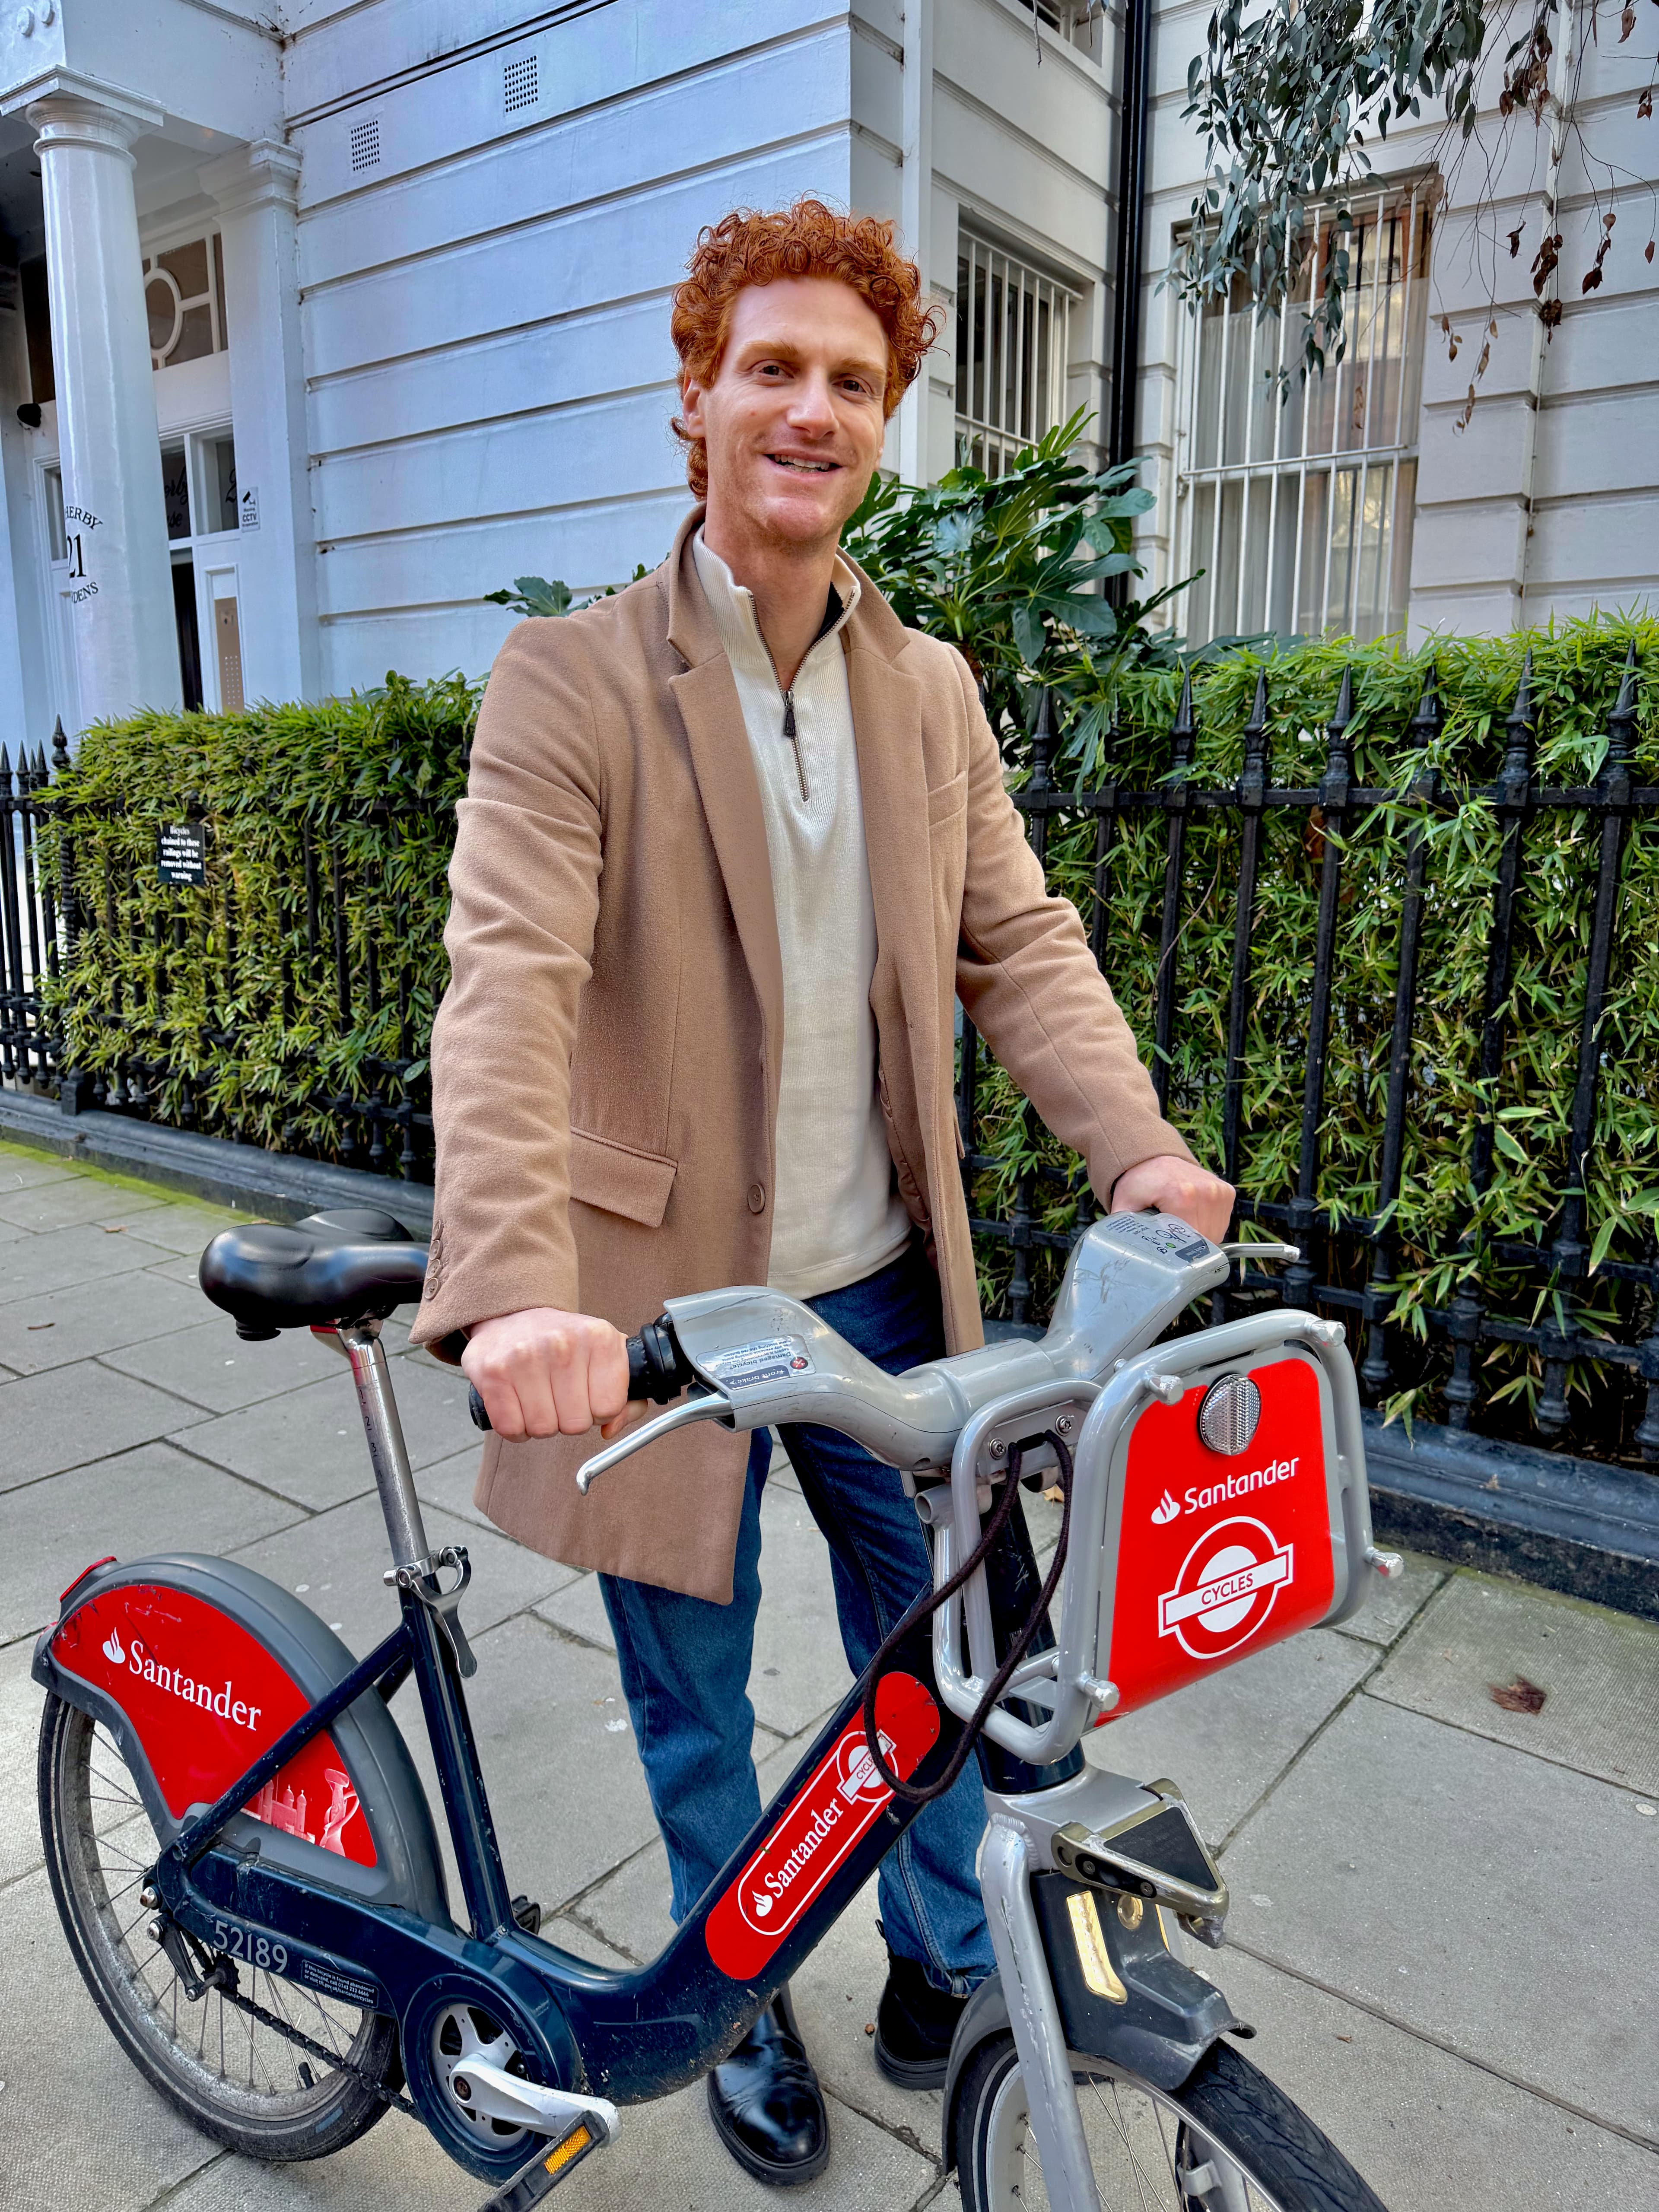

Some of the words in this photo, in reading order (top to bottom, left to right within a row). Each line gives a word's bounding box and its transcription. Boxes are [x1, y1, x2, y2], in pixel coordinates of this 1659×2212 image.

[242, 513, 257, 522] CCTV
[71, 582, 99, 604] DENS
[161, 836, 180, 845] chained
[187, 838, 200, 847] these
[163, 848, 181, 859] railings
[182, 849, 191, 858] will
[192, 849, 199, 858] be
[161, 860, 182, 868] removed
[183, 860, 202, 870] without
[171, 871, 192, 882] warning
[760, 1352, 791, 1363] Damaged
[730, 1360, 758, 1370] bicycle?
[365, 1416, 371, 1426] 2
[371, 1443, 376, 1452] 3
[1184, 1457, 1299, 1514] Santander
[1201, 1573, 1253, 1605] CYCLES
[129, 1640, 261, 1731] Santander
[856, 1756, 874, 1780] CYCLE
[764, 1798, 844, 1899] Santander
[213, 1920, 287, 1973] 52189
[317, 1968, 331, 1978] bicycle
[337, 1977, 349, 1985] found
[350, 1982, 374, 1993] abandoned
